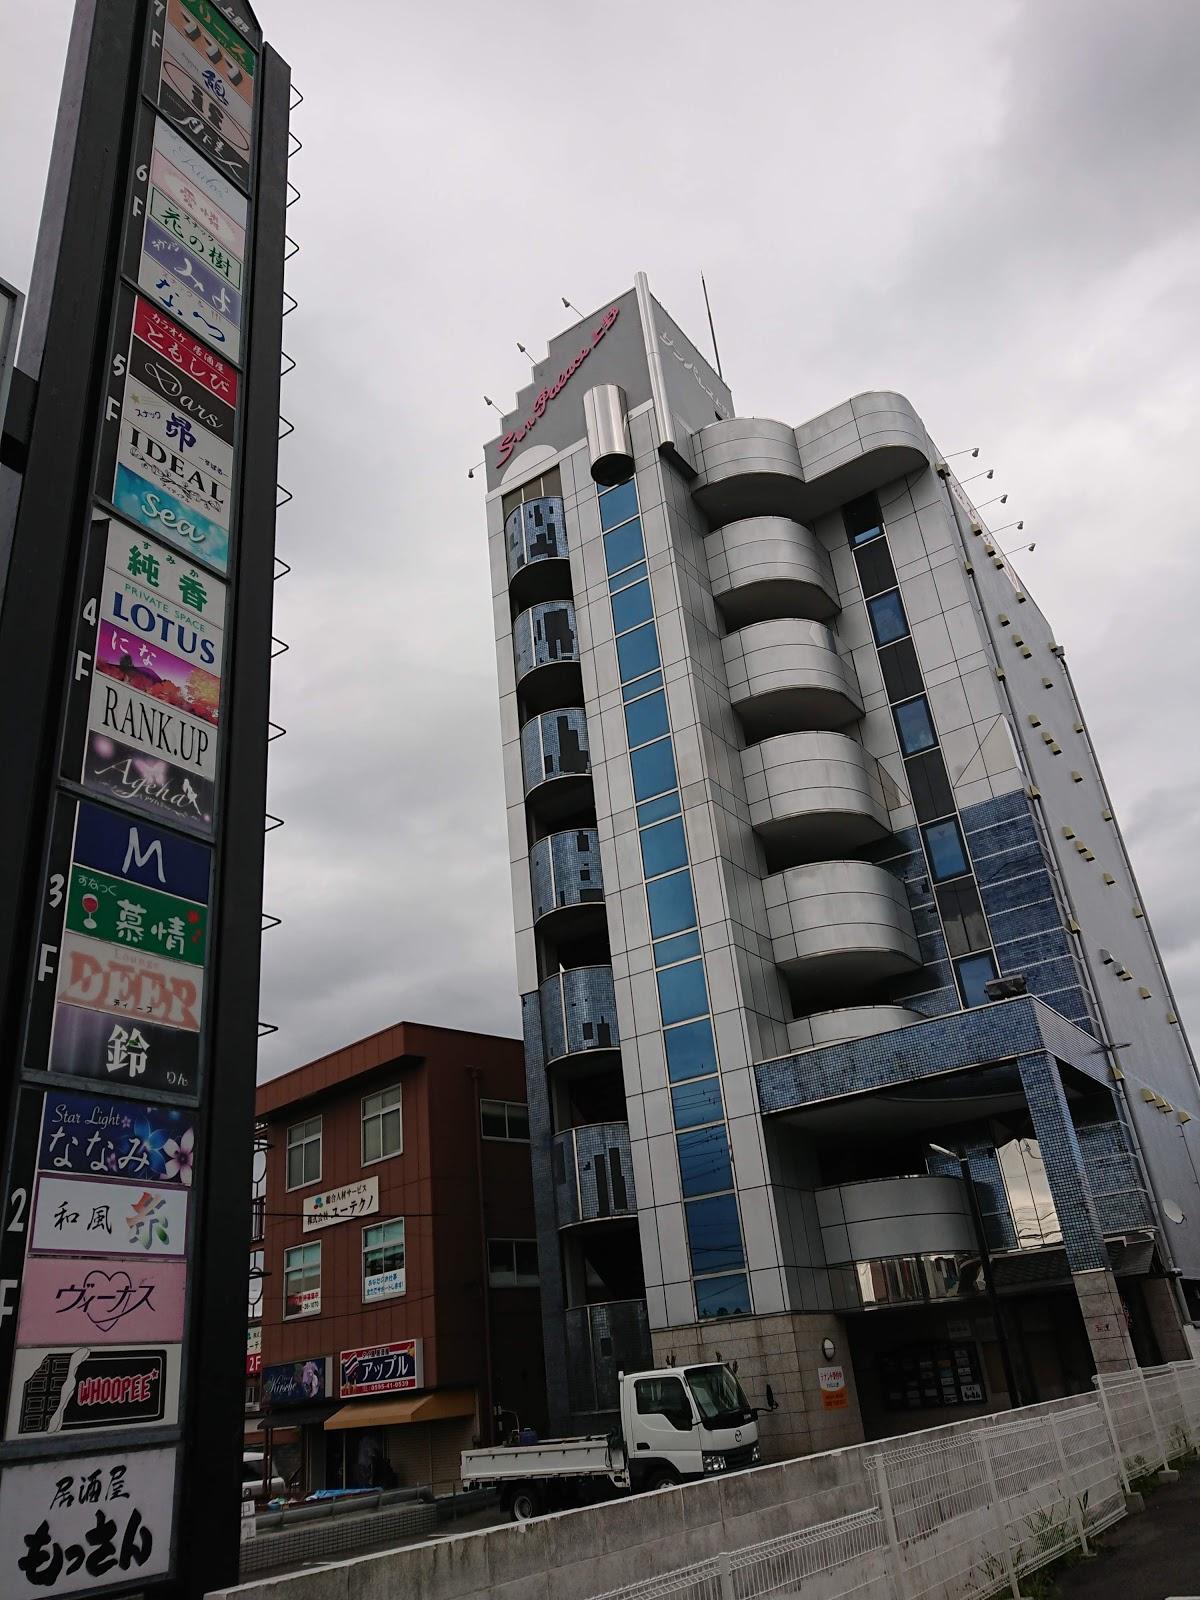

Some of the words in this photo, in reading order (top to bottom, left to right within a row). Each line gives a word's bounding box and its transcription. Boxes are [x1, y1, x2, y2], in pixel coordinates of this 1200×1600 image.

[216, 0, 250, 33] 上野
[161, 207, 232, 278] 花の樹
[174, 257, 231, 313] みよ
[151, 313, 187, 343] カラオケ
[146, 321, 230, 393] ともしび
[135, 407, 161, 420] スナック
[129, 427, 224, 504] IDEAL
[142, 493, 206, 543] Sea
[127, 545, 208, 613] 純香
[112, 591, 215, 664] LOTUS
[125, 583, 169, 613] PRIVATE
[174, 610, 205, 633] SPACE
[111, 630, 157, 667] にな
[102, 685, 209, 767] RANK.UP
[122, 827, 166, 883] M
[78, 874, 118, 897] すなっく
[116, 899, 186, 955] 慕情
[60, 951, 200, 1031] DEER
[106, 1024, 150, 1078] 鈴
[166, 1071, 189, 1087] りん
[52, 1103, 81, 1124] Star
[84, 1105, 120, 1130] Light
[49, 1126, 150, 1173] ななみ
[53, 1201, 112, 1235] 和風
[331, 1195, 373, 1219] ユーテクノ
[56, 1283, 156, 1324] ヴィーナス
[249, 1355, 261, 1372] 2F
[362, 1354, 409, 1381] アップル
[77, 1373, 152, 1406] WHOOPEE
[50, 1465, 131, 1510] 居酒屋
[18, 1508, 153, 1587] もっさん
